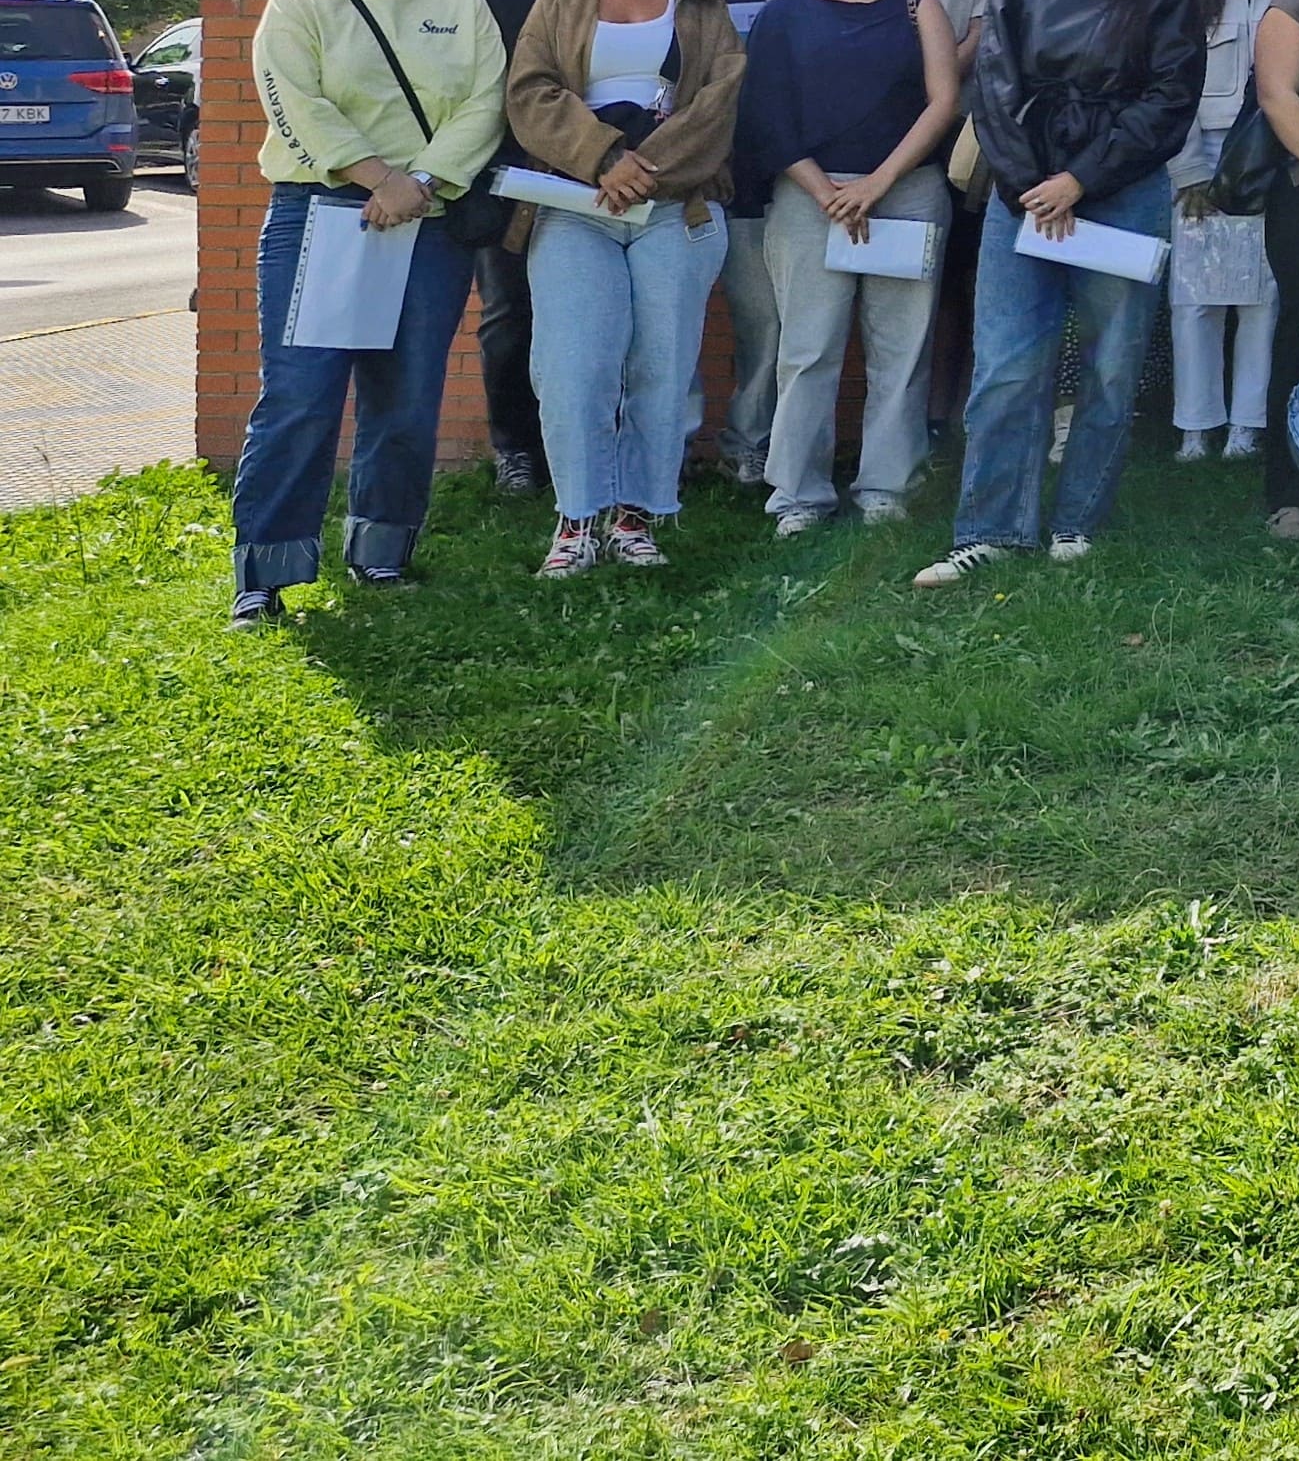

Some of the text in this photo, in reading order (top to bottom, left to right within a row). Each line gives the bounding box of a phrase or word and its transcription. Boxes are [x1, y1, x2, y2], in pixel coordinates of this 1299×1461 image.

[263, 68, 293, 138] CREATIVE
[16, 108, 46, 120] KBK
[288, 137, 300, 149] &
